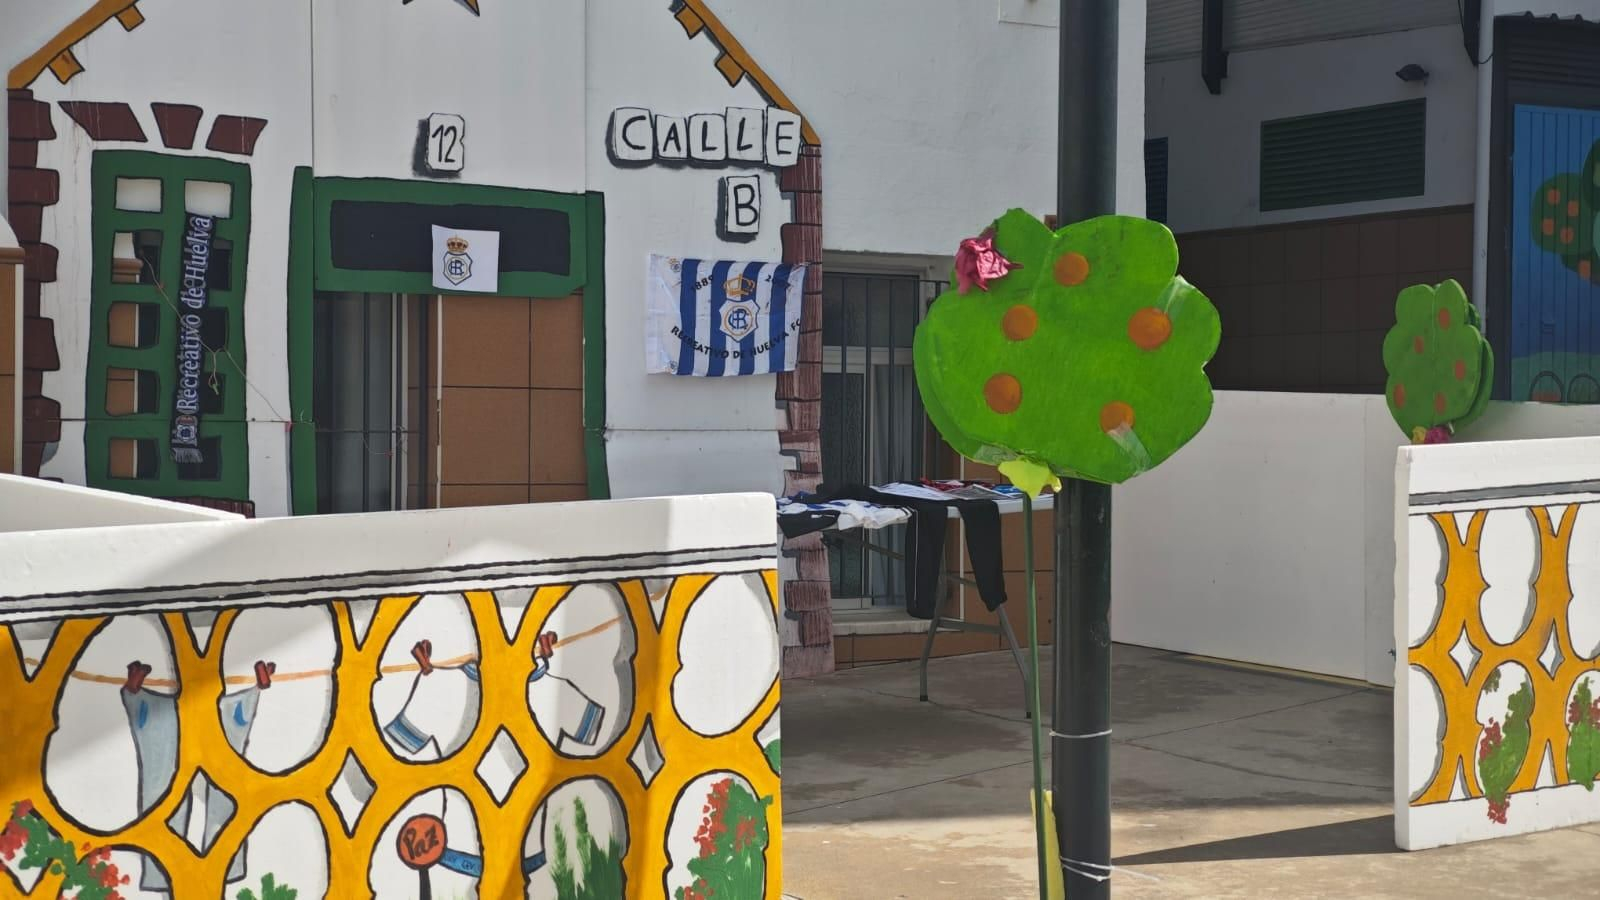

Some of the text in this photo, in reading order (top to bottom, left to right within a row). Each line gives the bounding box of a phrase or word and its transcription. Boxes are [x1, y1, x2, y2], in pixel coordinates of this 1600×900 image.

[431, 124, 457, 163] 12
[622, 115, 794, 155] CALLE
[734, 184, 759, 226] B
[176, 217, 211, 412] Recreativo de Huelva
[403, 824, 440, 860] Paz
